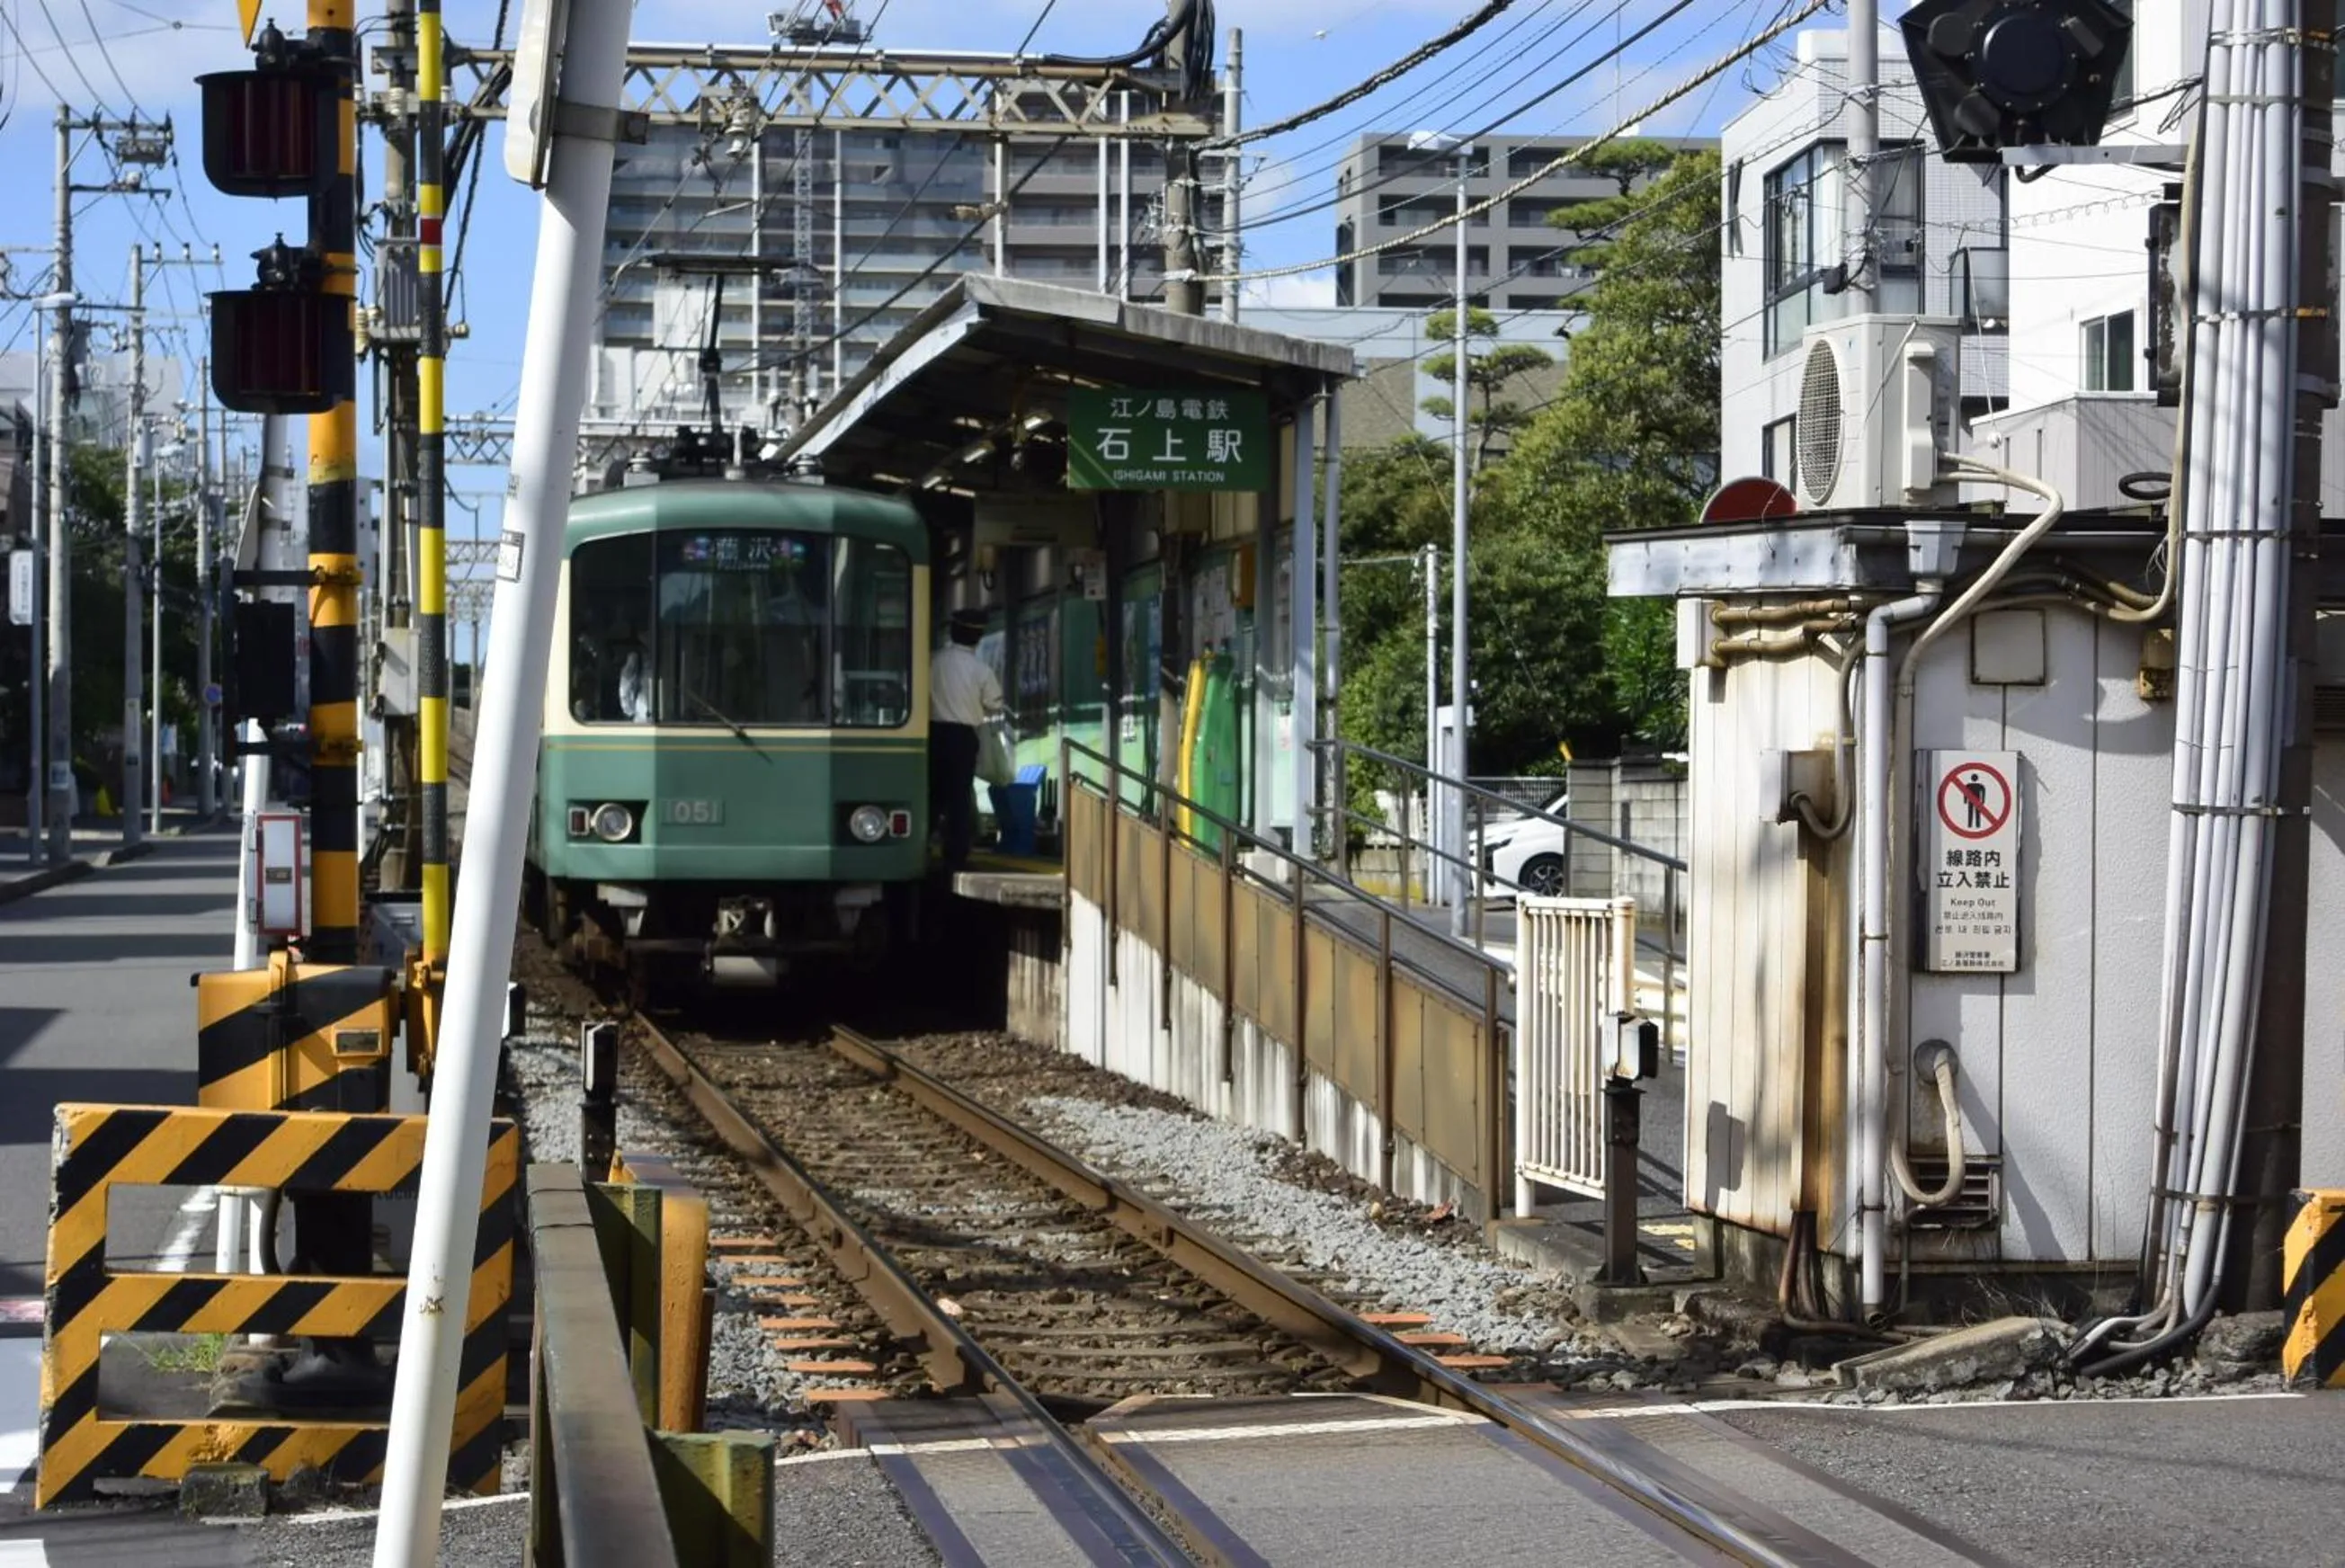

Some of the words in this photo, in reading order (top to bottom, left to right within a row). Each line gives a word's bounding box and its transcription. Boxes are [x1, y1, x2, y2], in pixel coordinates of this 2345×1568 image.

[1110, 397, 1229, 420] 江ノ島電鉄
[1096, 427, 1243, 463] 石上駅
[1113, 470, 1166, 481] ISHIGAMI
[1172, 470, 1225, 482] STATION
[1946, 850, 2001, 867] 線路内
[1936, 870, 2010, 889] 立入禁止
[1950, 897, 1975, 907] Keep
[1977, 897, 1996, 906] Out
